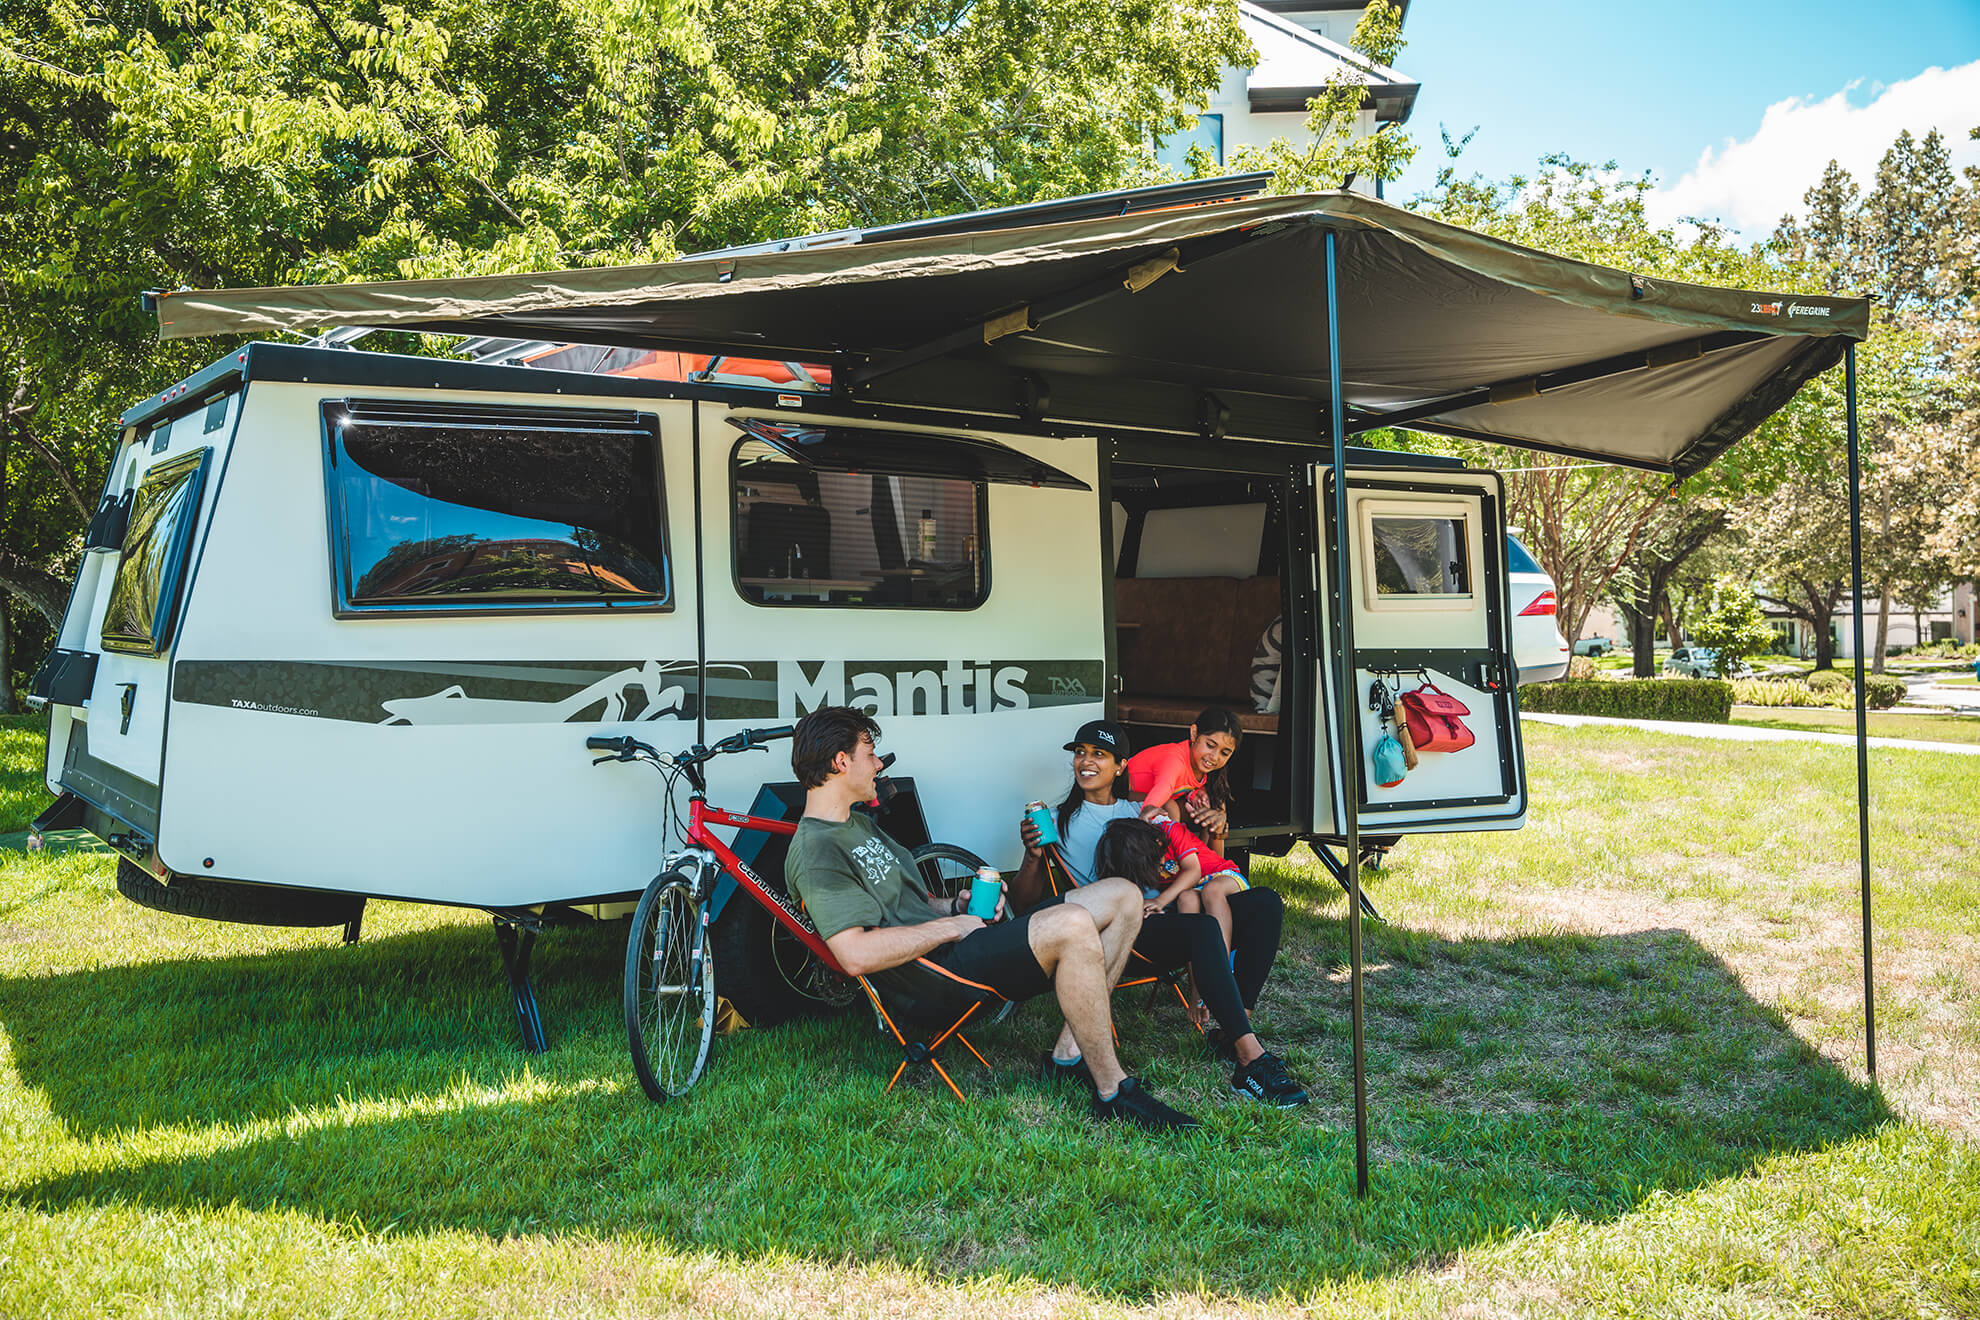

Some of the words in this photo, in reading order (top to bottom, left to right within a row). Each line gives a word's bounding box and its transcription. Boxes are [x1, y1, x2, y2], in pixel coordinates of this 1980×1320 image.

[1789, 306, 1831, 316] PEREGRINE
[777, 660, 1030, 717] Mantis
[231, 699, 319, 716] TAXAoutdoors.com
[737, 860, 815, 933] cannondale
